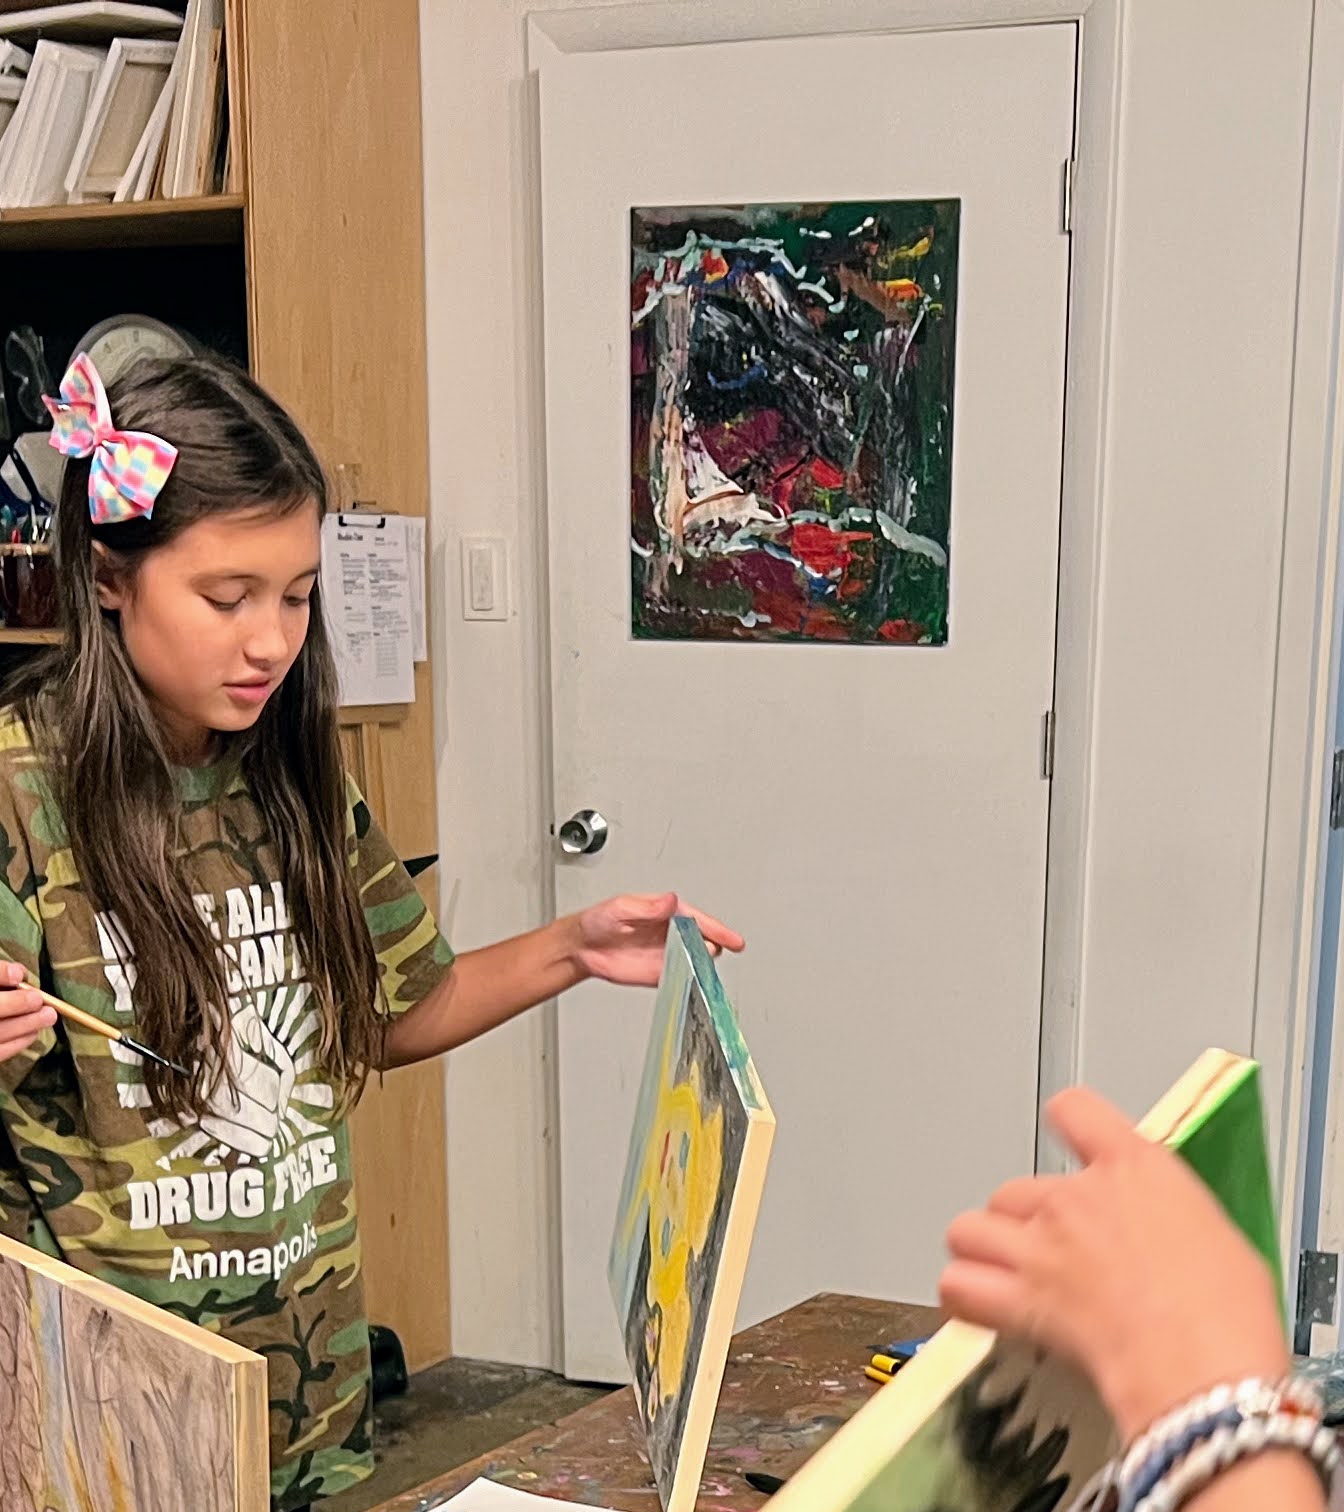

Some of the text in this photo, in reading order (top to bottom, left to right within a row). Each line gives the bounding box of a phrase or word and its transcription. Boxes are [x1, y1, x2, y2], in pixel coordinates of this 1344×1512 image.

[225, 881, 291, 938] ALL
[127, 1136, 337, 1230] DRUG FREE
[169, 1222, 317, 1283] Annapolis
